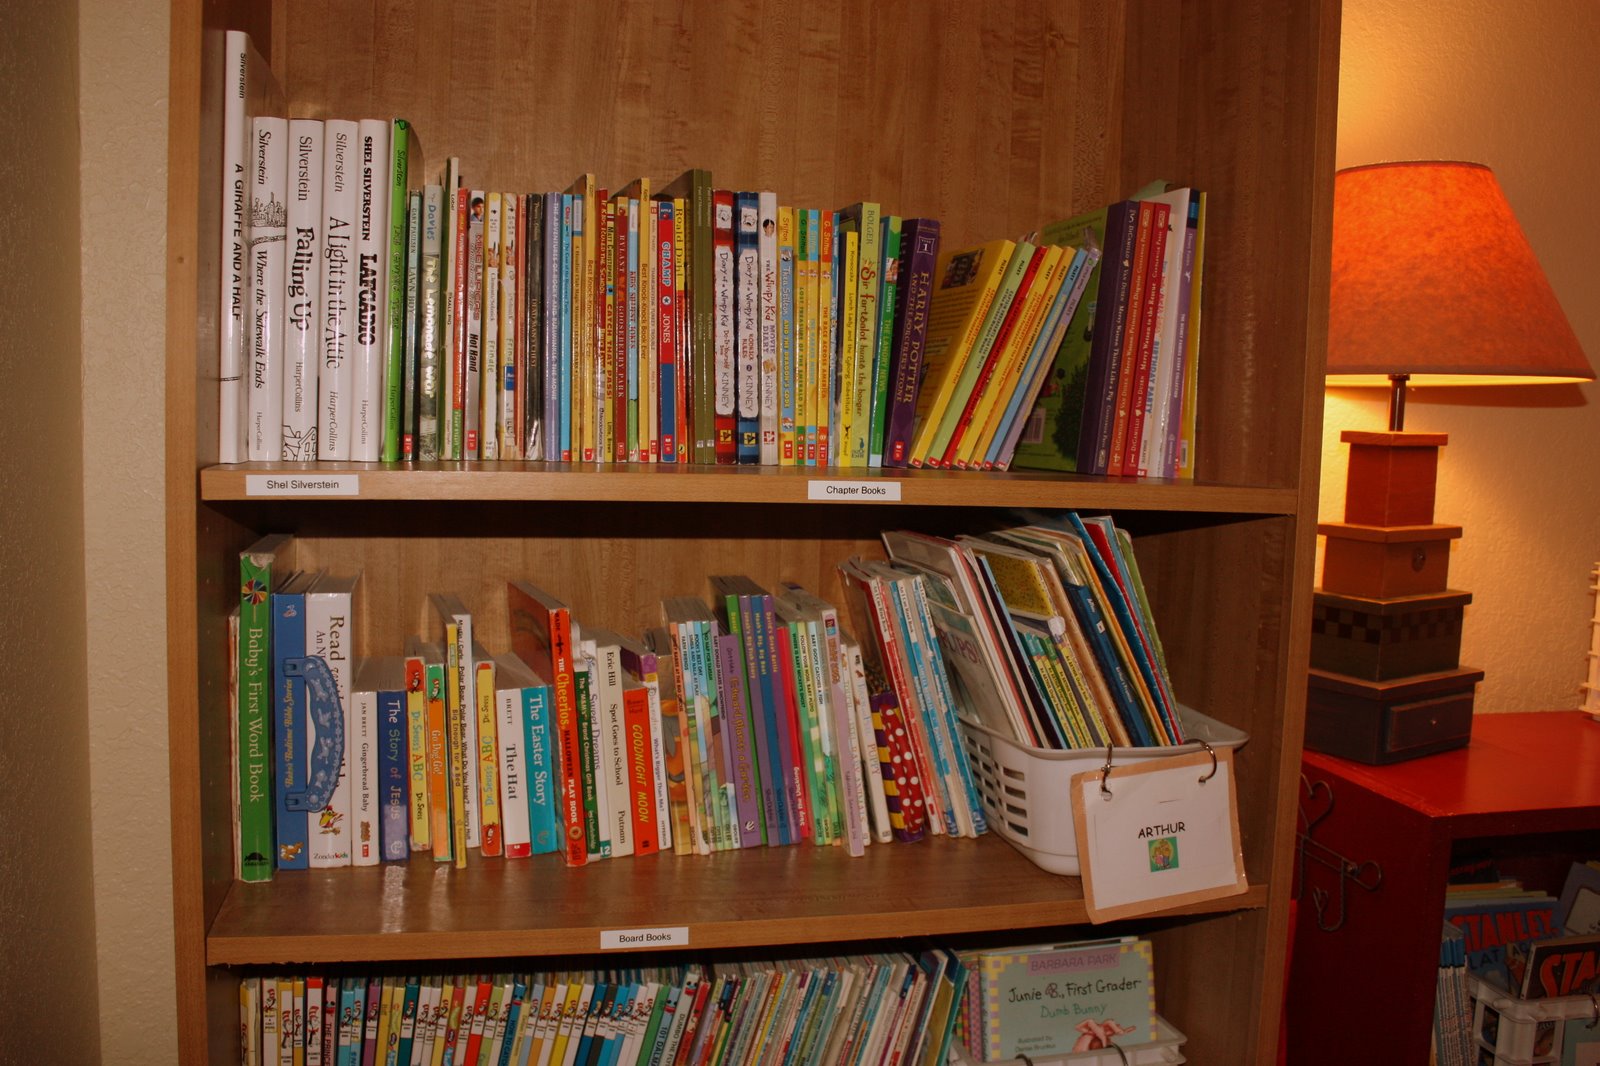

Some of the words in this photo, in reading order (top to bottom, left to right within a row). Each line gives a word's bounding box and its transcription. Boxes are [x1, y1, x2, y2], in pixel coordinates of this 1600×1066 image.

[258, 130, 271, 184] Silverstein
[334, 133, 347, 192] Silverstein
[364, 136, 372, 166] SHEL
[235, 164, 244, 172] A
[298, 136, 312, 201] Silverstein
[396, 150, 404, 187] Silverstein
[234, 180, 243, 238] GIRAFFE
[362, 168, 372, 240] SILVERSTEIN
[329, 216, 350, 230] A
[427, 205, 436, 240] Davies
[866, 210, 874, 245] BOLGER
[233, 243, 242, 270] AND
[256, 250, 267, 280] Where
[288, 227, 314, 298] Falling
[325, 235, 350, 279] Light
[662, 241, 671, 287] CHAMP
[676, 248, 684, 276] Dahl
[720, 252, 728, 273] Diary
[745, 256, 754, 278] Diary
[233, 275, 241, 284] A
[328, 280, 347, 296] in
[763, 272, 774, 304] Wimpy
[861, 267, 876, 289] Sir
[232, 286, 240, 321] HALF
[256, 290, 264, 306] the
[358, 253, 378, 345] LAFCADIO
[719, 290, 728, 314] Wimpy
[743, 292, 753, 317] Wimpy
[782, 289, 792, 316] Stilton
[913, 272, 929, 336] HARRY
[290, 302, 312, 332] Up
[328, 299, 347, 327] the
[721, 315, 729, 326] Kid
[746, 318, 754, 330] Kid
[765, 306, 776, 321] Kid
[256, 308, 266, 358] Sidewalk
[470, 334, 478, 348] Hot
[663, 314, 671, 343] JONES
[326, 328, 347, 369] Attic
[470, 350, 478, 372] Hand
[1150, 340, 1160, 384] BIRTHDAY
[255, 361, 265, 388] Ends
[903, 341, 920, 403] POTTER
[294, 362, 303, 412] HarperCollins
[745, 375, 753, 412] KINNEY
[765, 375, 773, 409] KINNEY
[1146, 386, 1154, 414] PARTY
[857, 389, 865, 416] booger
[328, 391, 338, 451] HarperCollins
[266, 480, 288, 489] Shel
[291, 480, 339, 490] Silverstein
[826, 486, 859, 495] Chapter
[861, 486, 886, 494] Books
[245, 627, 263, 676] Baby's
[330, 616, 345, 661] Read
[249, 682, 263, 713] First
[388, 700, 400, 723] The
[530, 694, 542, 720] The
[556, 673, 571, 725] Cheerios
[590, 694, 599, 725] Sweet
[610, 704, 618, 722] Spot
[249, 717, 263, 758] Word
[388, 729, 400, 761] Story
[431, 730, 441, 742] Go
[531, 725, 545, 766] Easter
[612, 725, 620, 745] Goes
[506, 744, 517, 771] The
[592, 730, 601, 770] Dreams
[614, 747, 620, 756] to
[632, 724, 647, 786] GOODNIGHT
[867, 744, 880, 775] PUPPY
[360, 743, 369, 790] Gingerbread
[390, 767, 401, 779] of
[414, 754, 423, 781] ABC
[433, 761, 442, 775] Go!
[615, 758, 623, 785] School
[250, 764, 264, 802] Book
[508, 774, 519, 800] Hat
[533, 771, 547, 806] Story
[361, 793, 369, 812] Baby
[390, 786, 401, 820] JESUS
[637, 791, 648, 823] MOON
[618, 810, 626, 844] Putnam
[1138, 822, 1186, 839] ARTHUR
[619, 934, 643, 943] Board
[646, 933, 671, 942] Books
[1451, 909, 1552, 952] STANLEY
[1031, 957, 1084, 971] BARBARA
[1086, 953, 1118, 965] PARK
[1008, 988, 1042, 1003] Junie
[1066, 981, 1092, 997] First
[1096, 977, 1142, 992] Grader
[1040, 1005, 1070, 1018] Dumb
[1073, 1003, 1108, 1016] Bunny
[658, 1025, 667, 1039] 101
[672, 1012, 685, 1039] DUMBO
[669, 1040, 677, 1053] THE
